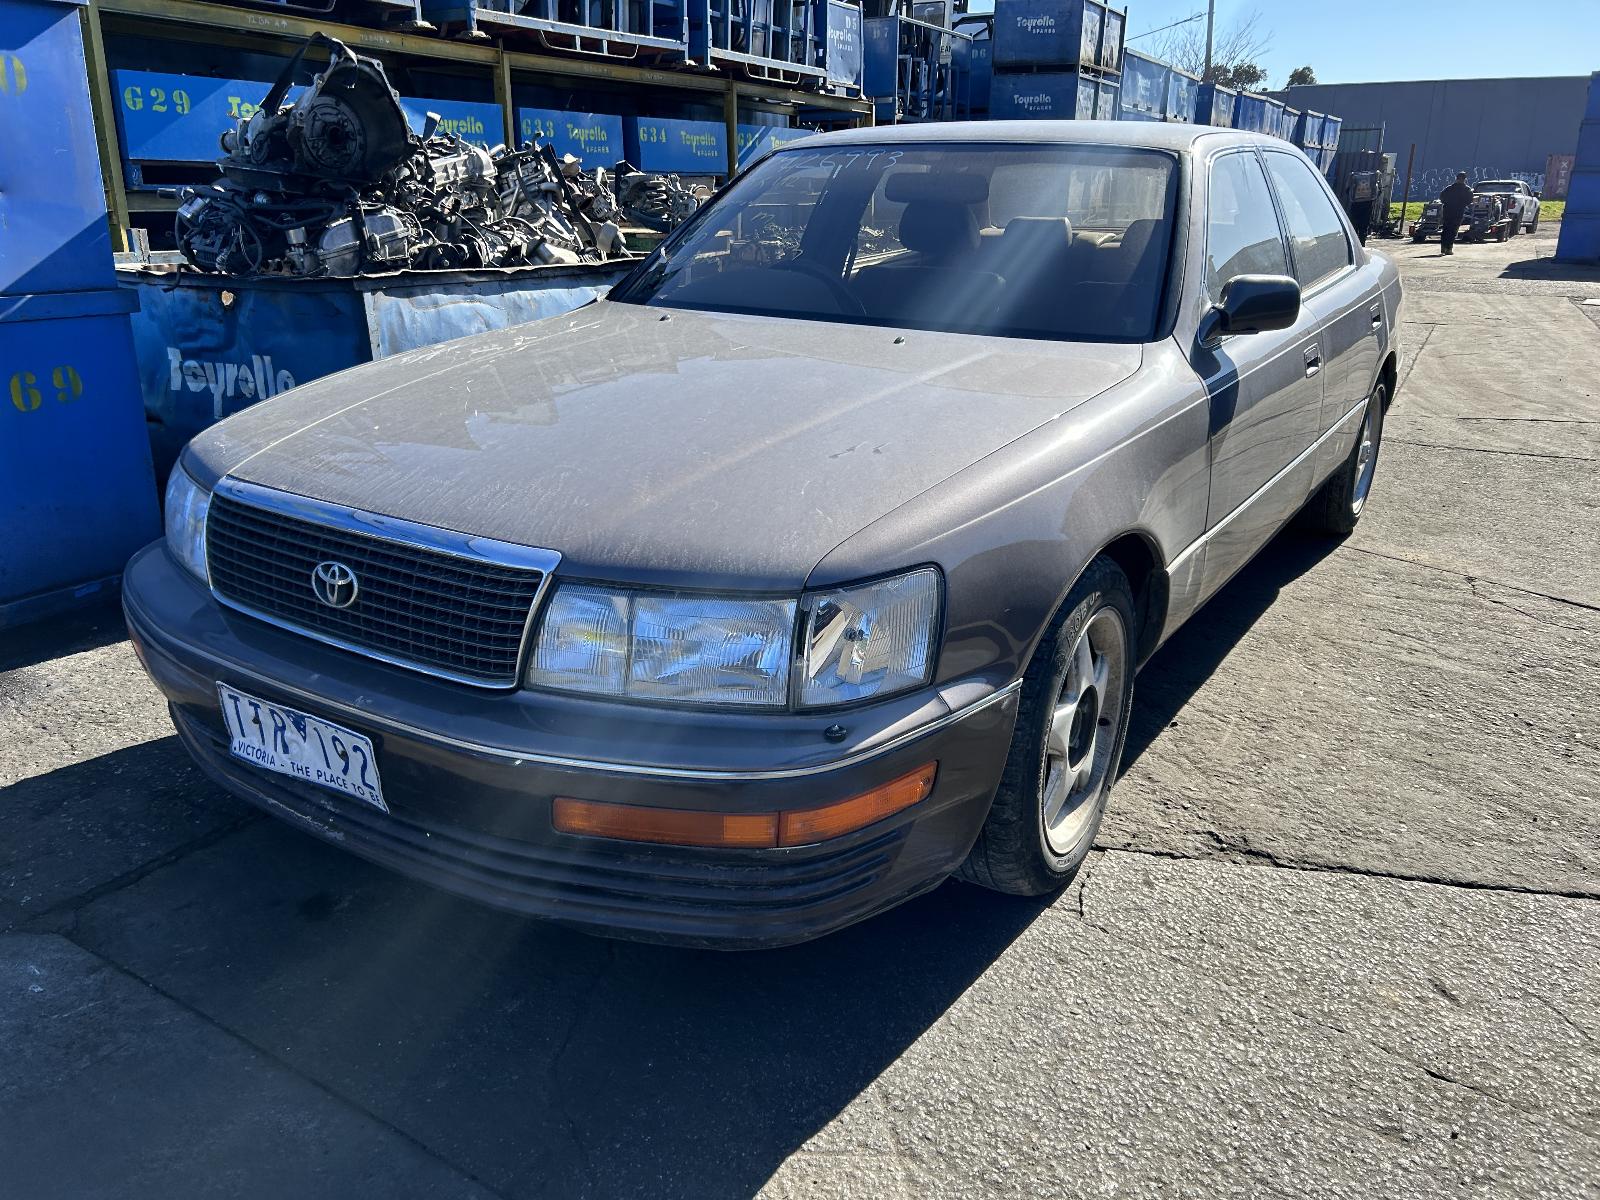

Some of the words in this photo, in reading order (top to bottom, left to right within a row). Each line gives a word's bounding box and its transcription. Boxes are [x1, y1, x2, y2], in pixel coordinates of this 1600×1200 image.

[124, 86, 191, 115] G29
[10, 365, 83, 413] 69
[238, 740, 276, 767] VICTORIA
[290, 761, 311, 778] THE
[316, 769, 348, 790] PLACE
[351, 782, 365, 796] TO
[313, 726, 376, 792] 192
